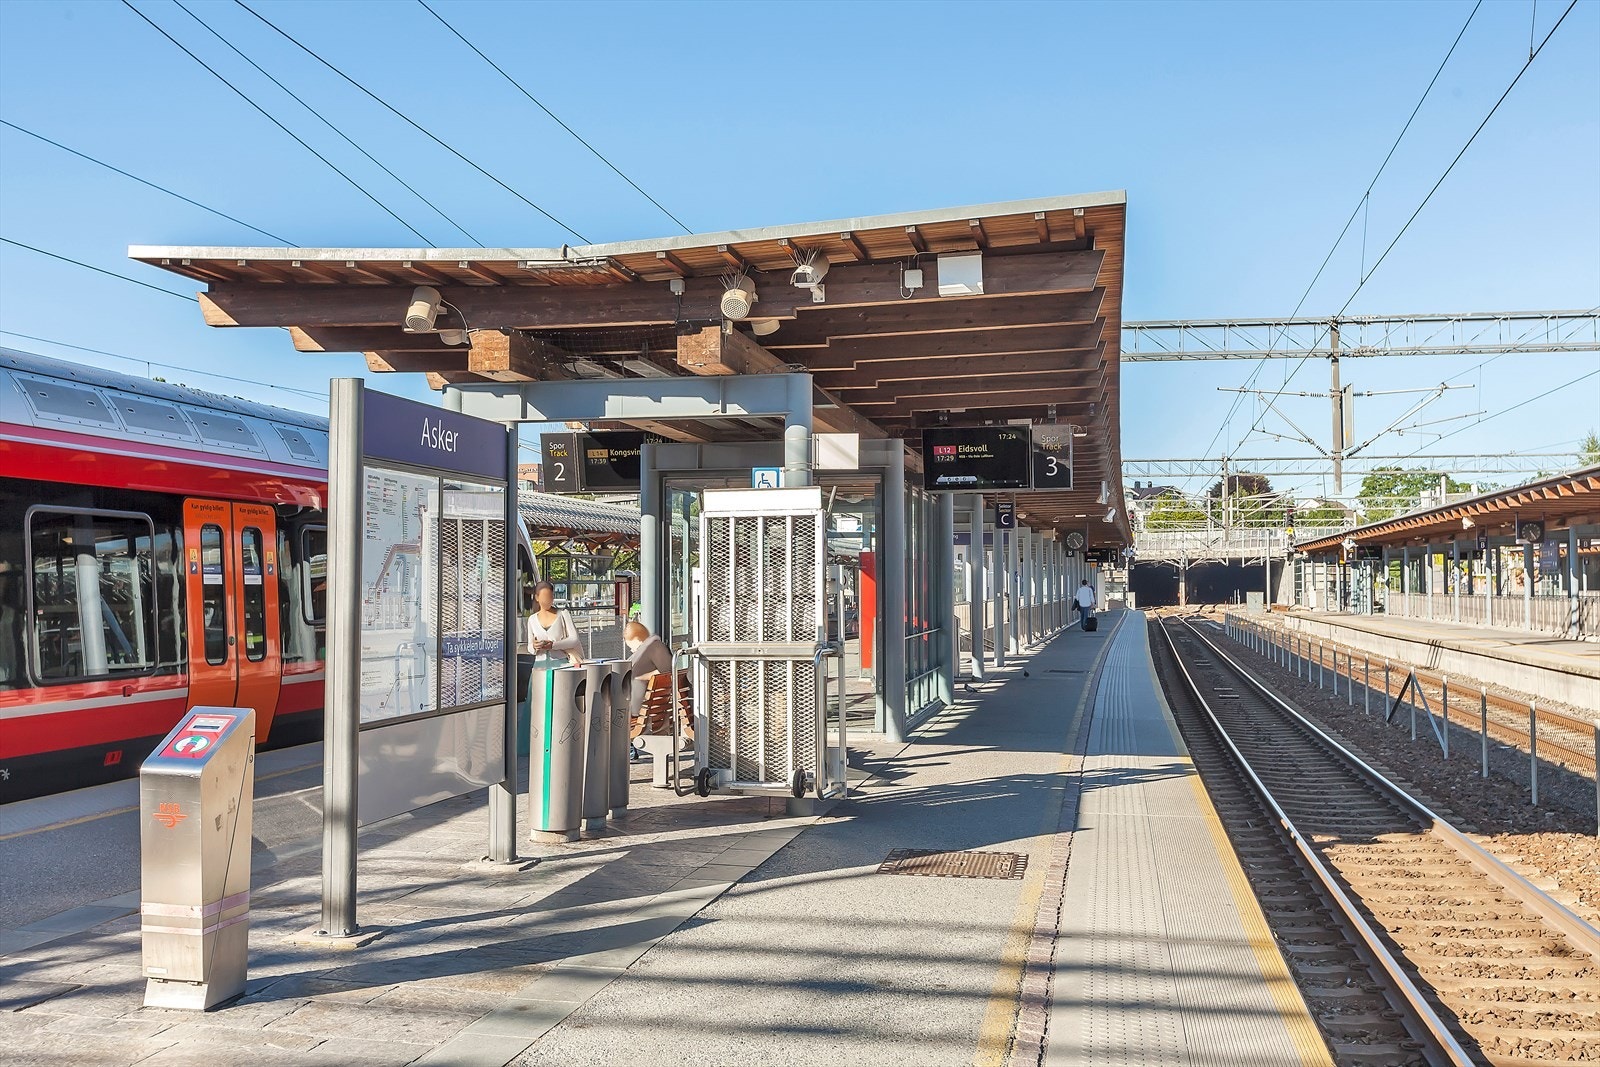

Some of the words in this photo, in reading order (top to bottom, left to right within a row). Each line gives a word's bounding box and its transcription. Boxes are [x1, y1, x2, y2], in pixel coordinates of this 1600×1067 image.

[421, 417, 459, 452] Asker
[1041, 434, 1060, 442] Spor
[549, 442, 566, 450] Spor
[958, 444, 988, 453] Eidsvoll
[1041, 442, 1063, 450] Track
[1046, 456, 1058, 476] 3
[553, 462, 566, 481] 2
[1001, 513, 1010, 525] C
[446, 642, 454, 653] Ta
[160, 803, 180, 813] NSB
